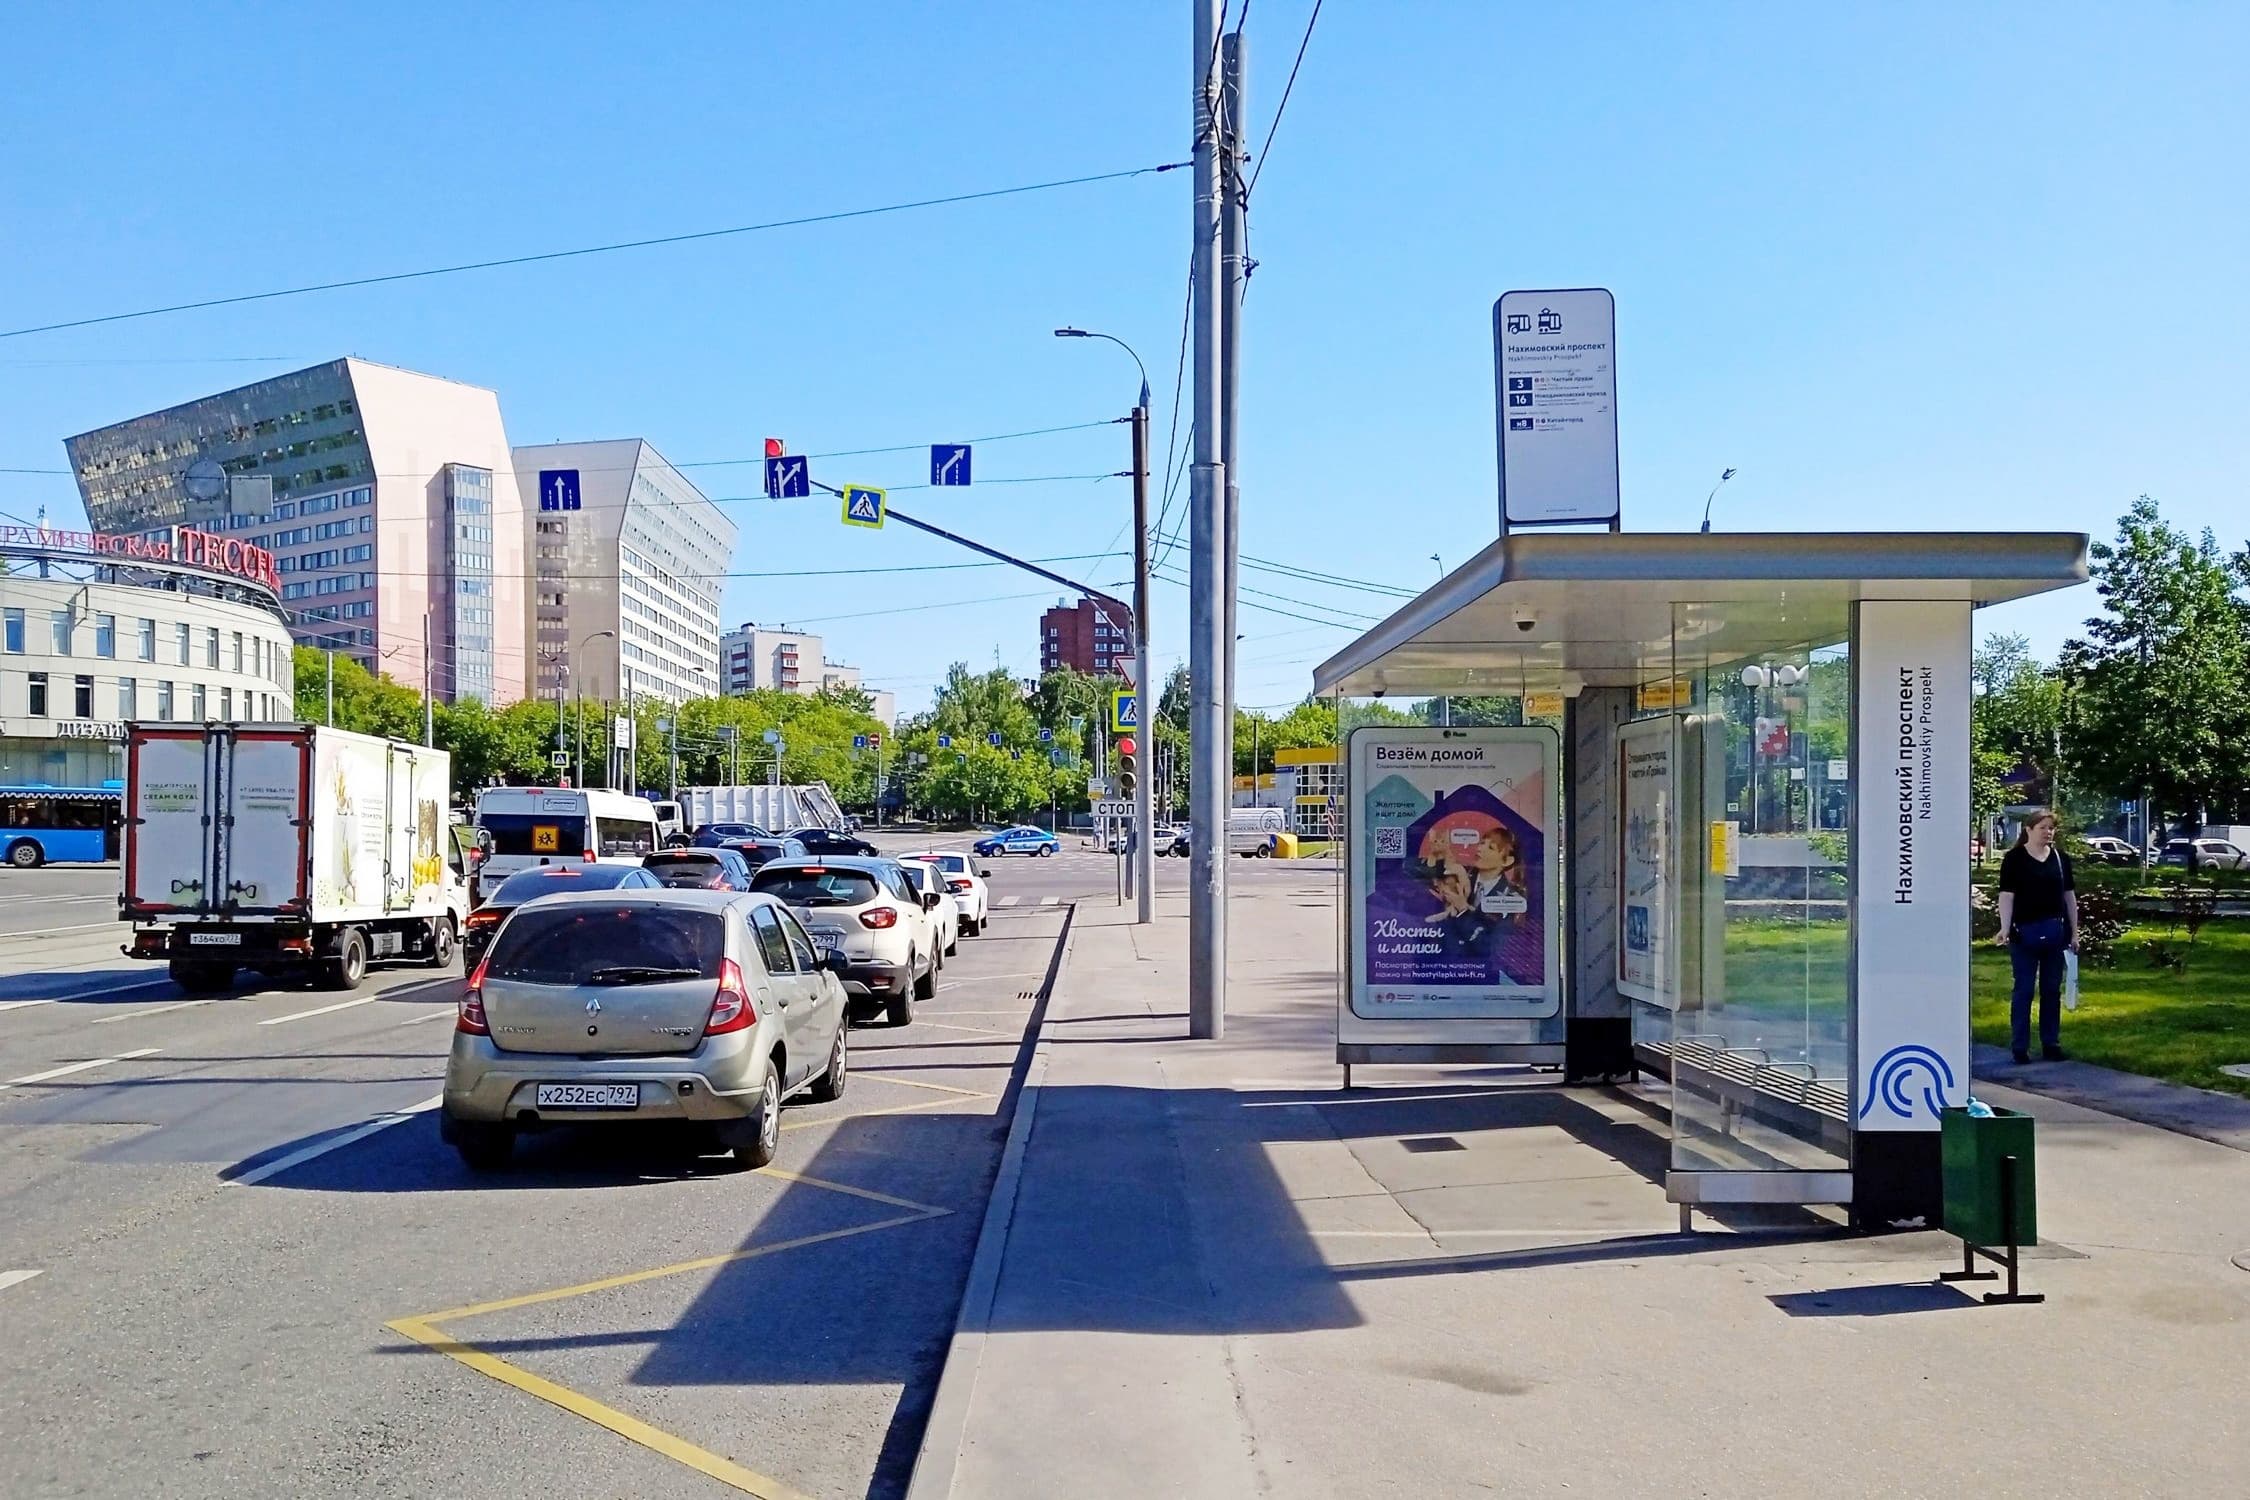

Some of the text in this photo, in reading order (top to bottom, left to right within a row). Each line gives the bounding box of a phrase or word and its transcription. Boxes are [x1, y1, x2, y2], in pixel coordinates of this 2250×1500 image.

[1508, 343, 1605, 353] Нахимовский проспект
[1517, 380, 1524, 389] 3
[1516, 395, 1527, 405] 16
[0, 526, 170, 560] РАМИЧЕСКАЯ
[1919, 666, 1934, 819] Nakhimovskiy Prospekt
[1376, 747, 1484, 762] Везём домой
[1895, 667, 1917, 903] Нахимовский проспект
[1098, 803, 1135, 815] СТОП
[1373, 918, 1445, 938] Хвосты
[1377, 942, 1442, 954] и лапки
[1375, 961, 1420, 970] Посмотреть
